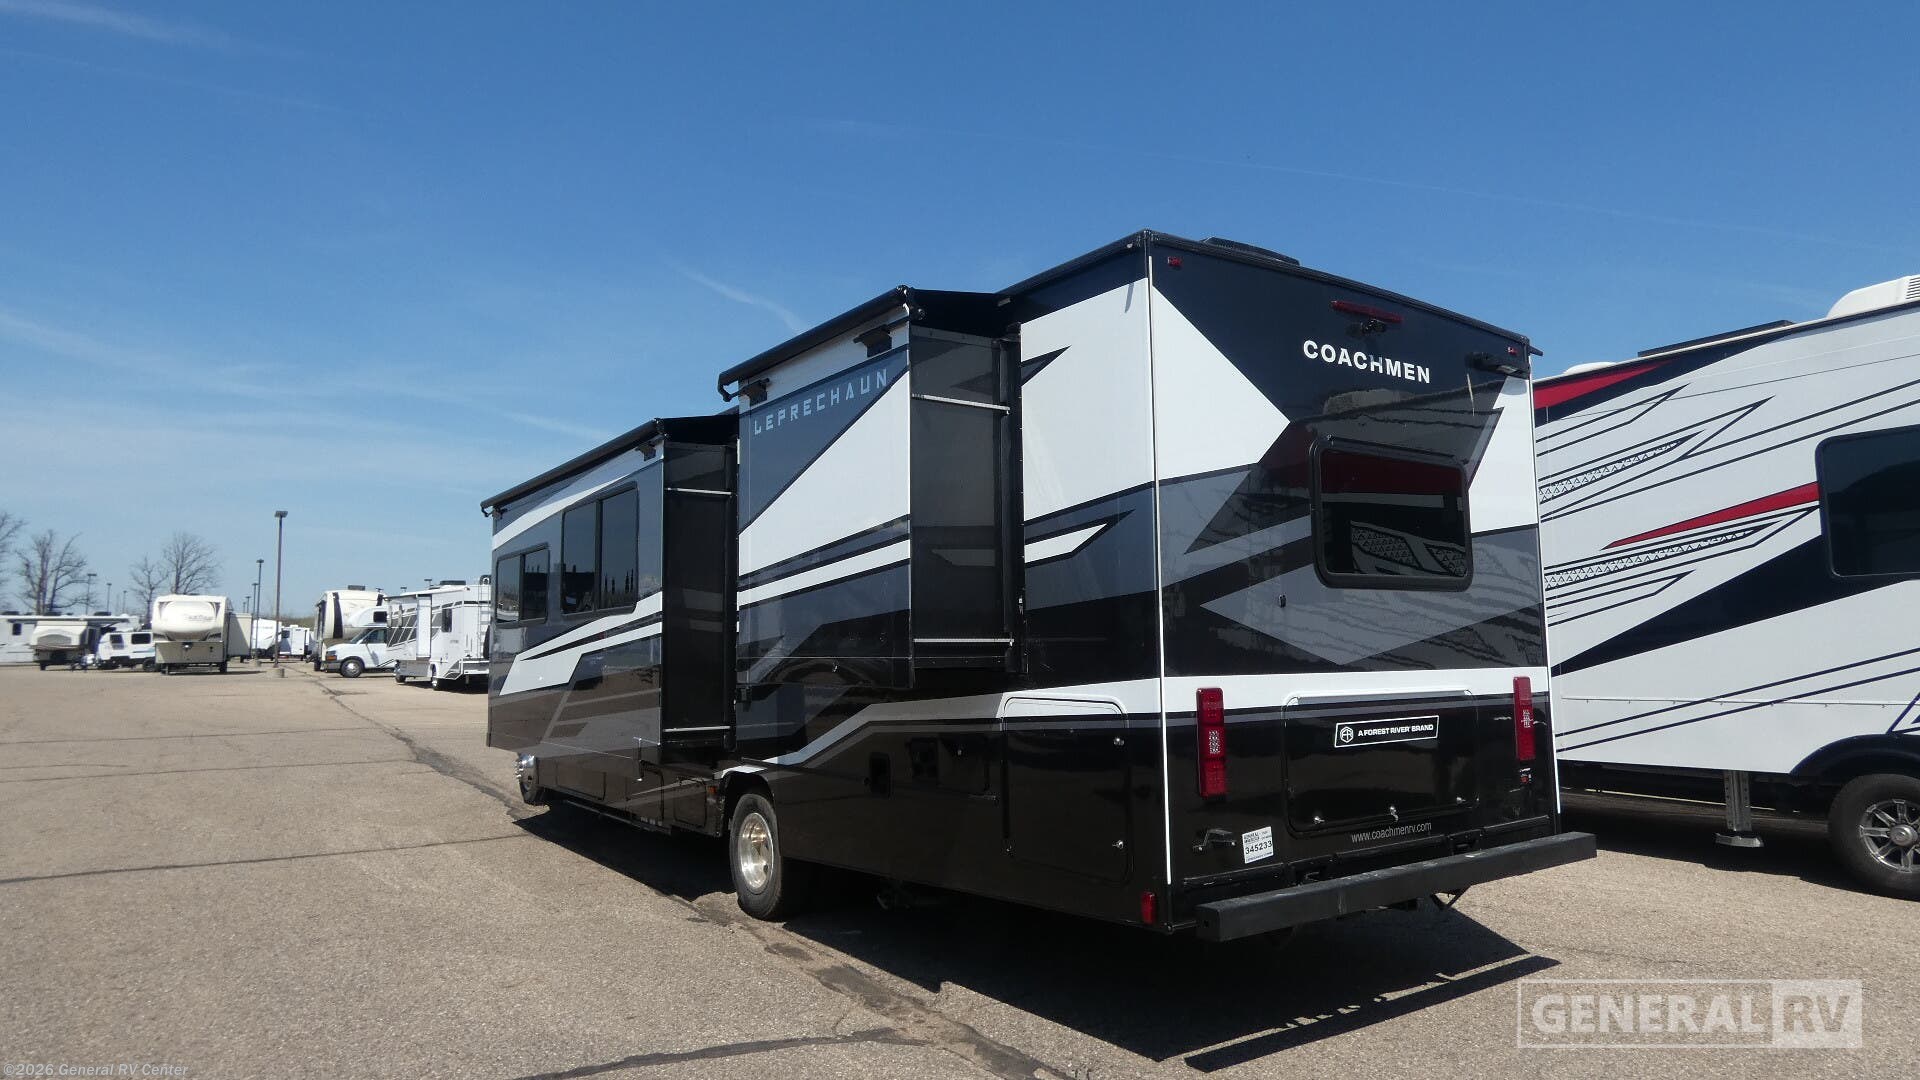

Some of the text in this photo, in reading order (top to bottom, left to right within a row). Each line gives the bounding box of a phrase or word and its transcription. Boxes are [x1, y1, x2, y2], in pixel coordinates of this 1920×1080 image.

[1303, 339, 1430, 384] COACHMEN
[753, 368, 888, 435] LEPRECHAUN
[1364, 728, 1390, 736] FOREST
[1390, 726, 1411, 734] RIVER
[1411, 724, 1434, 732] BRAND
[1351, 822, 1432, 843] www.coachmenrv.com
[1245, 840, 1273, 855] 345233
